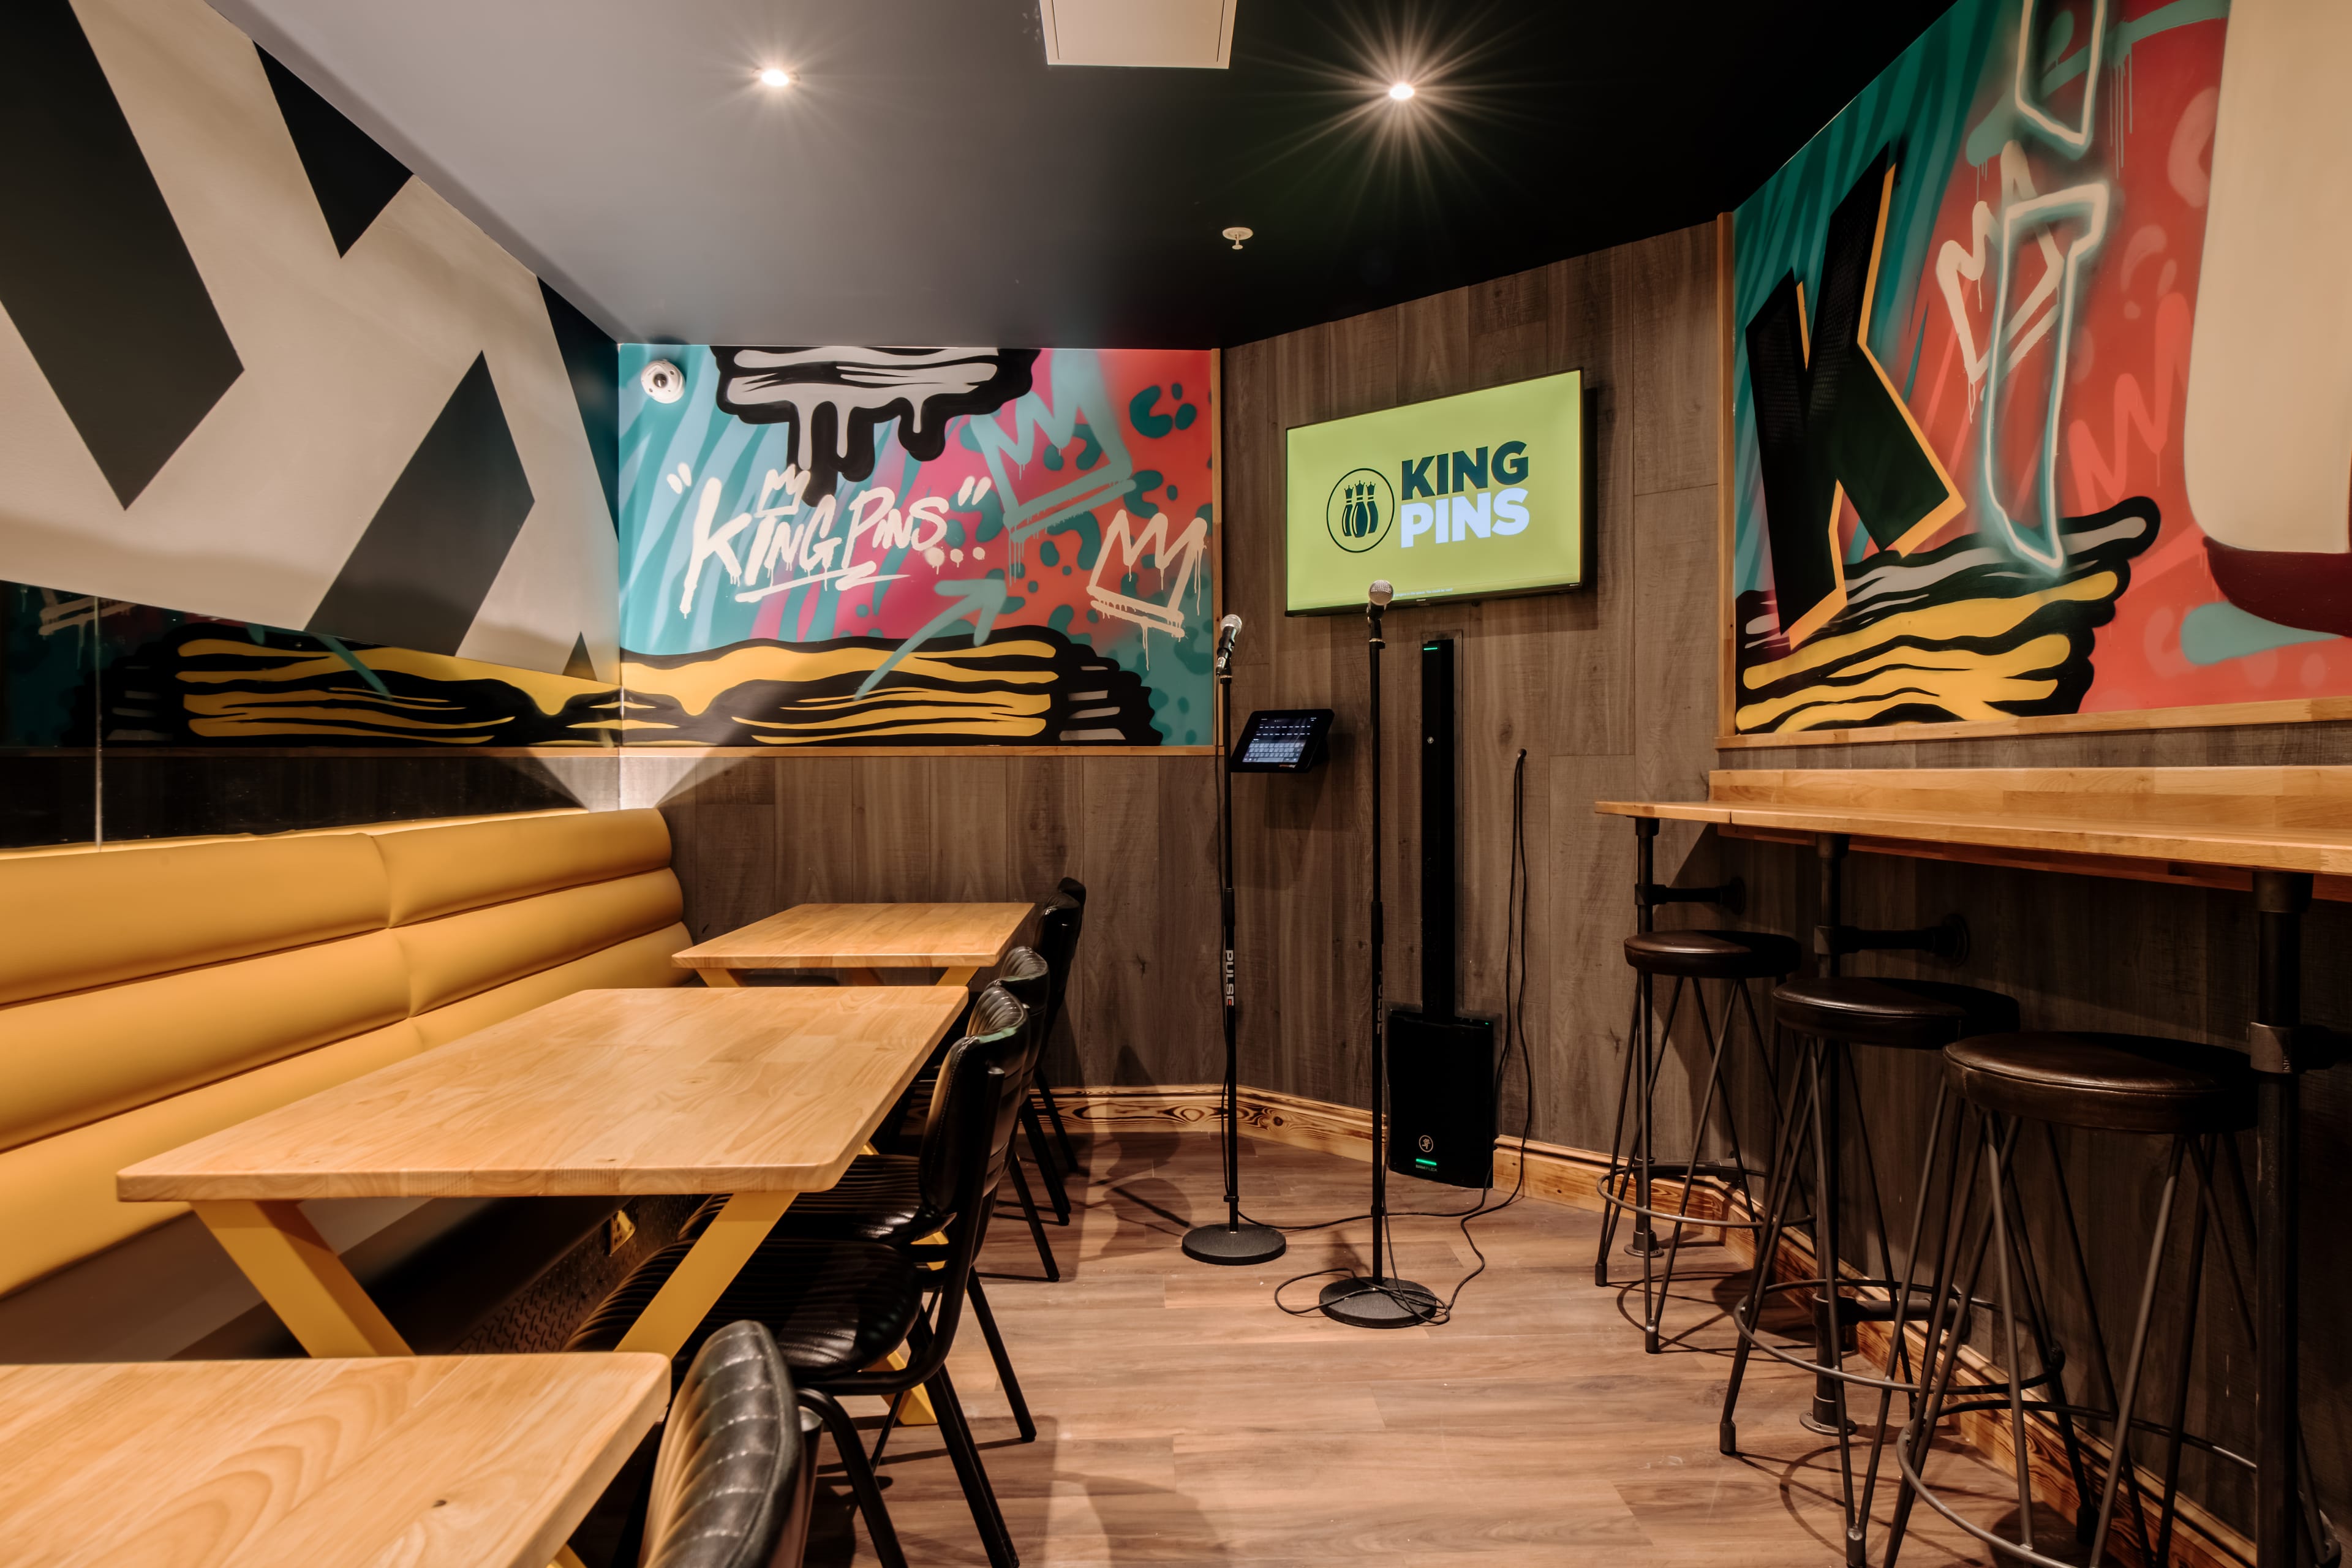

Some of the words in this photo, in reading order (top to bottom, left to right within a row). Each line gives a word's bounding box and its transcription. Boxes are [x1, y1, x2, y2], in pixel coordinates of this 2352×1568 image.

[1401, 440, 1529, 500] KING
[1401, 488, 1530, 548] PINS
[1226, 949, 1234, 1006] PULSE
